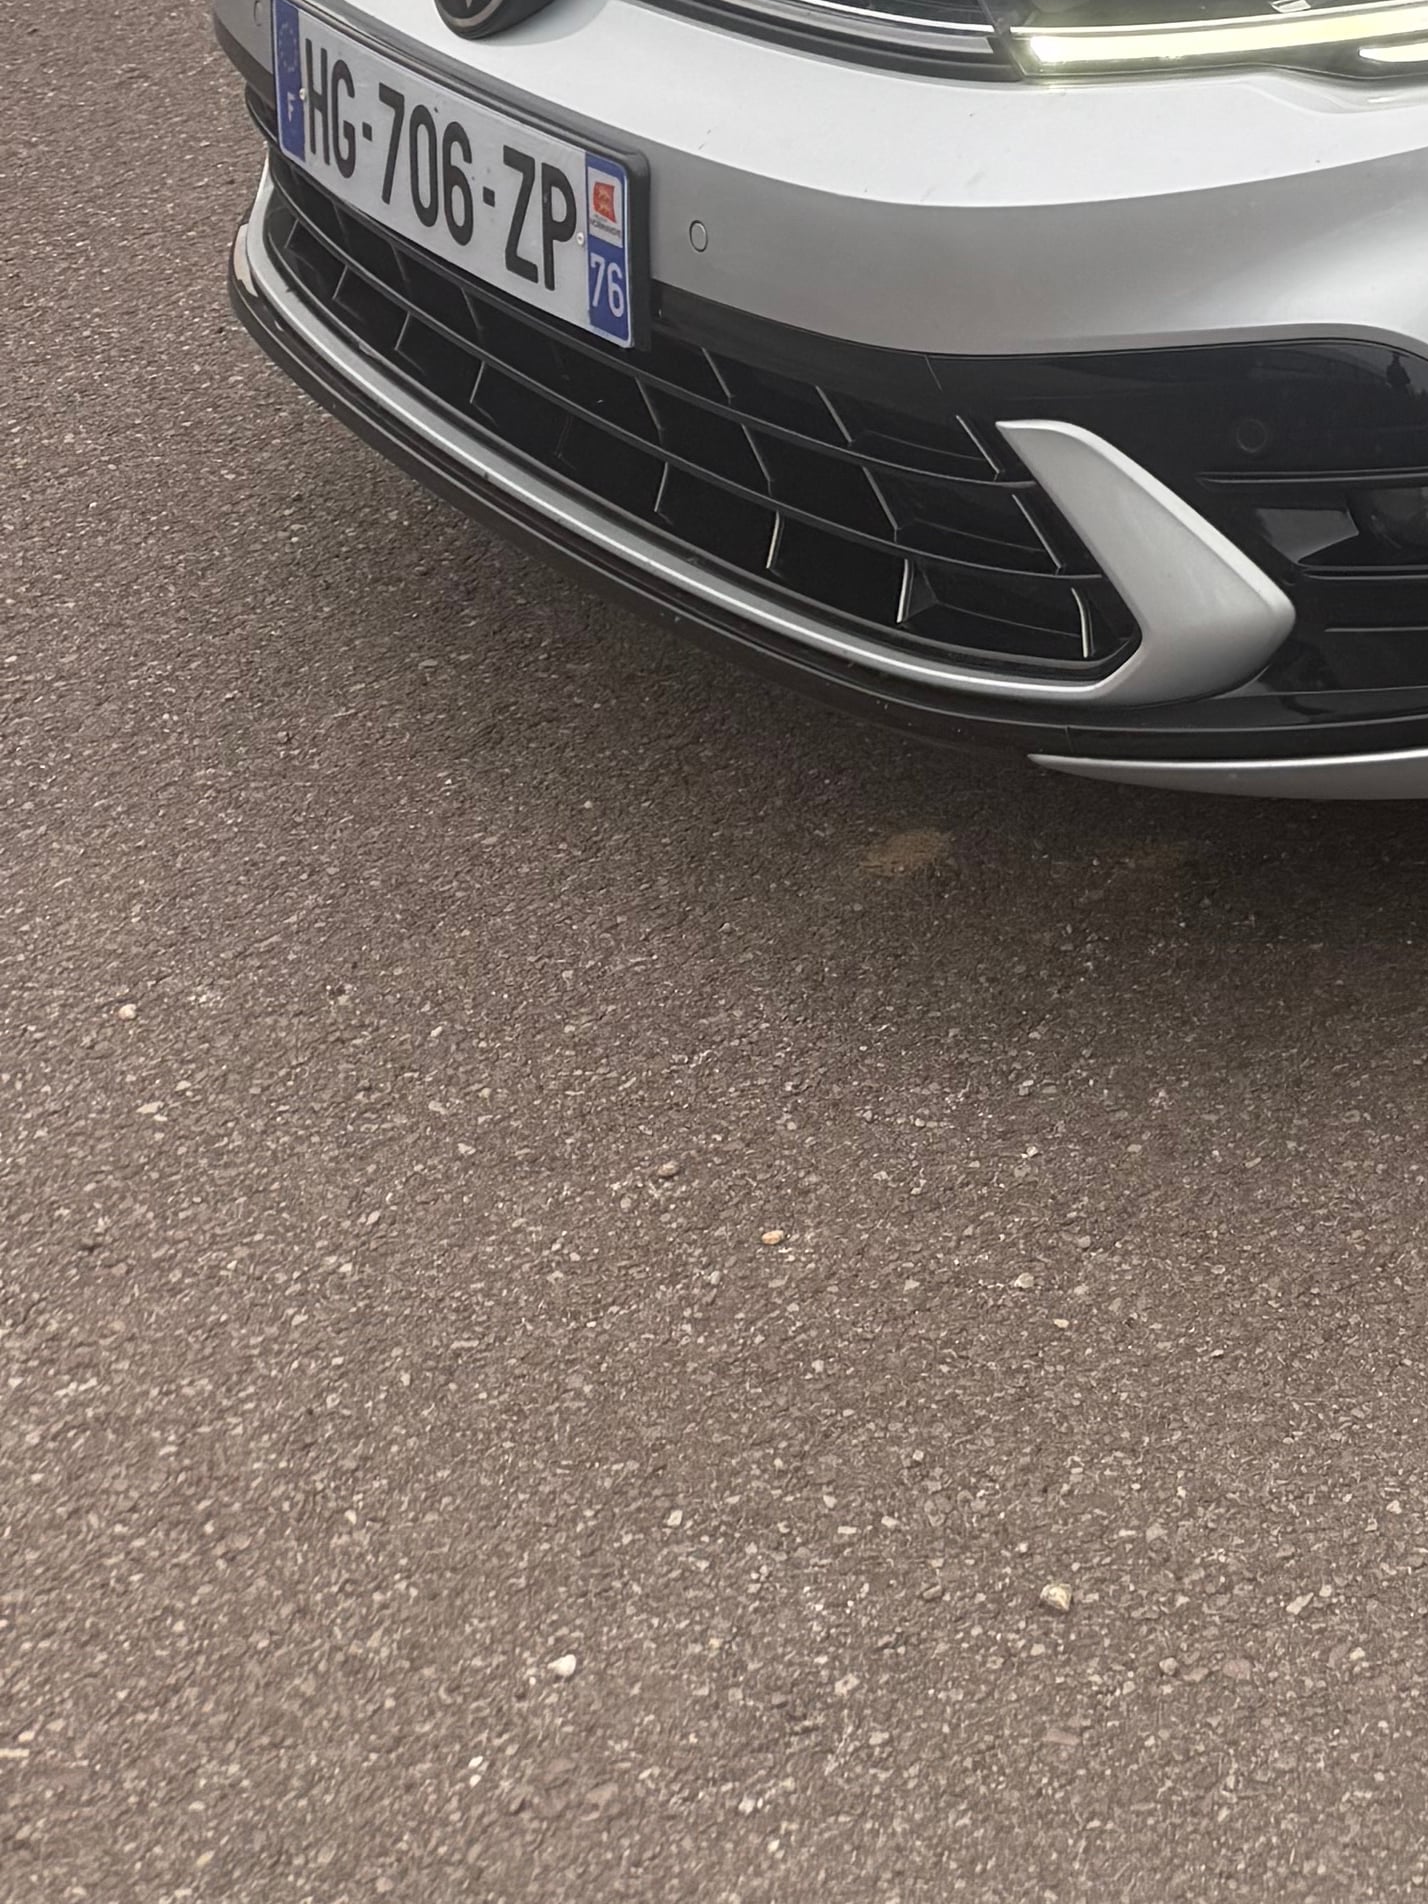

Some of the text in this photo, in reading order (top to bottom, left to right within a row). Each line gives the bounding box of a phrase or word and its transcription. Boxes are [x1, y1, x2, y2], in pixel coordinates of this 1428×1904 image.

[287, 91, 296, 122] F
[305, 37, 577, 291] HG-706-ZP
[590, 253, 624, 318] 76
